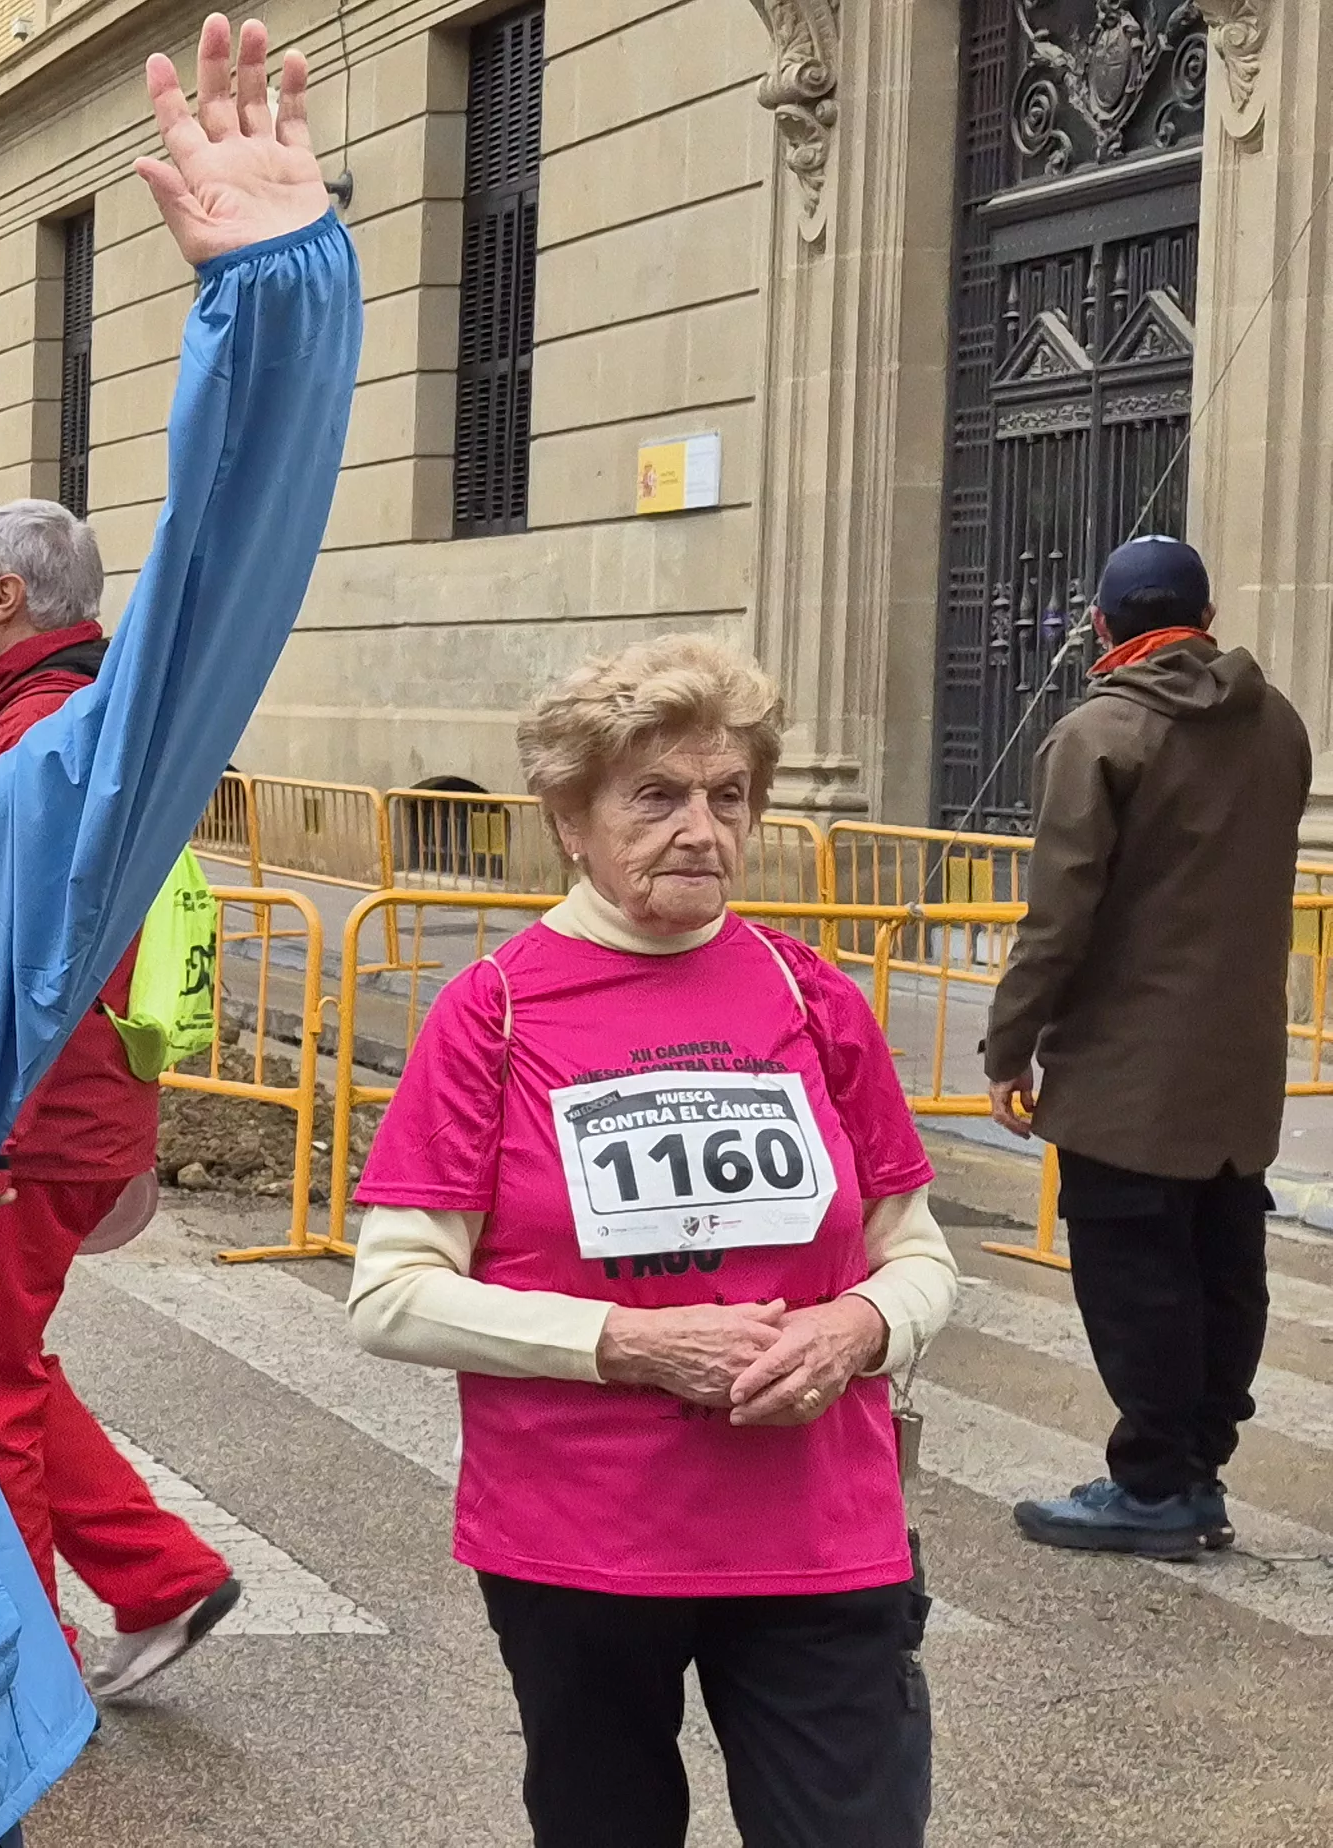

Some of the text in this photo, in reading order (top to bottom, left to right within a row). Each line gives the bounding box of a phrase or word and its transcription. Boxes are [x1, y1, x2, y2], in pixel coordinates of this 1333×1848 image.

[629, 1040, 733, 1064] XII CARRERA
[639, 1057, 707, 1075] CONTRA
[710, 1058, 732, 1072] EL
[654, 1090, 716, 1106] HUESCA
[586, 1100, 787, 1134] CONTRA EL CÁNCER
[592, 1128, 804, 1203] 1160
